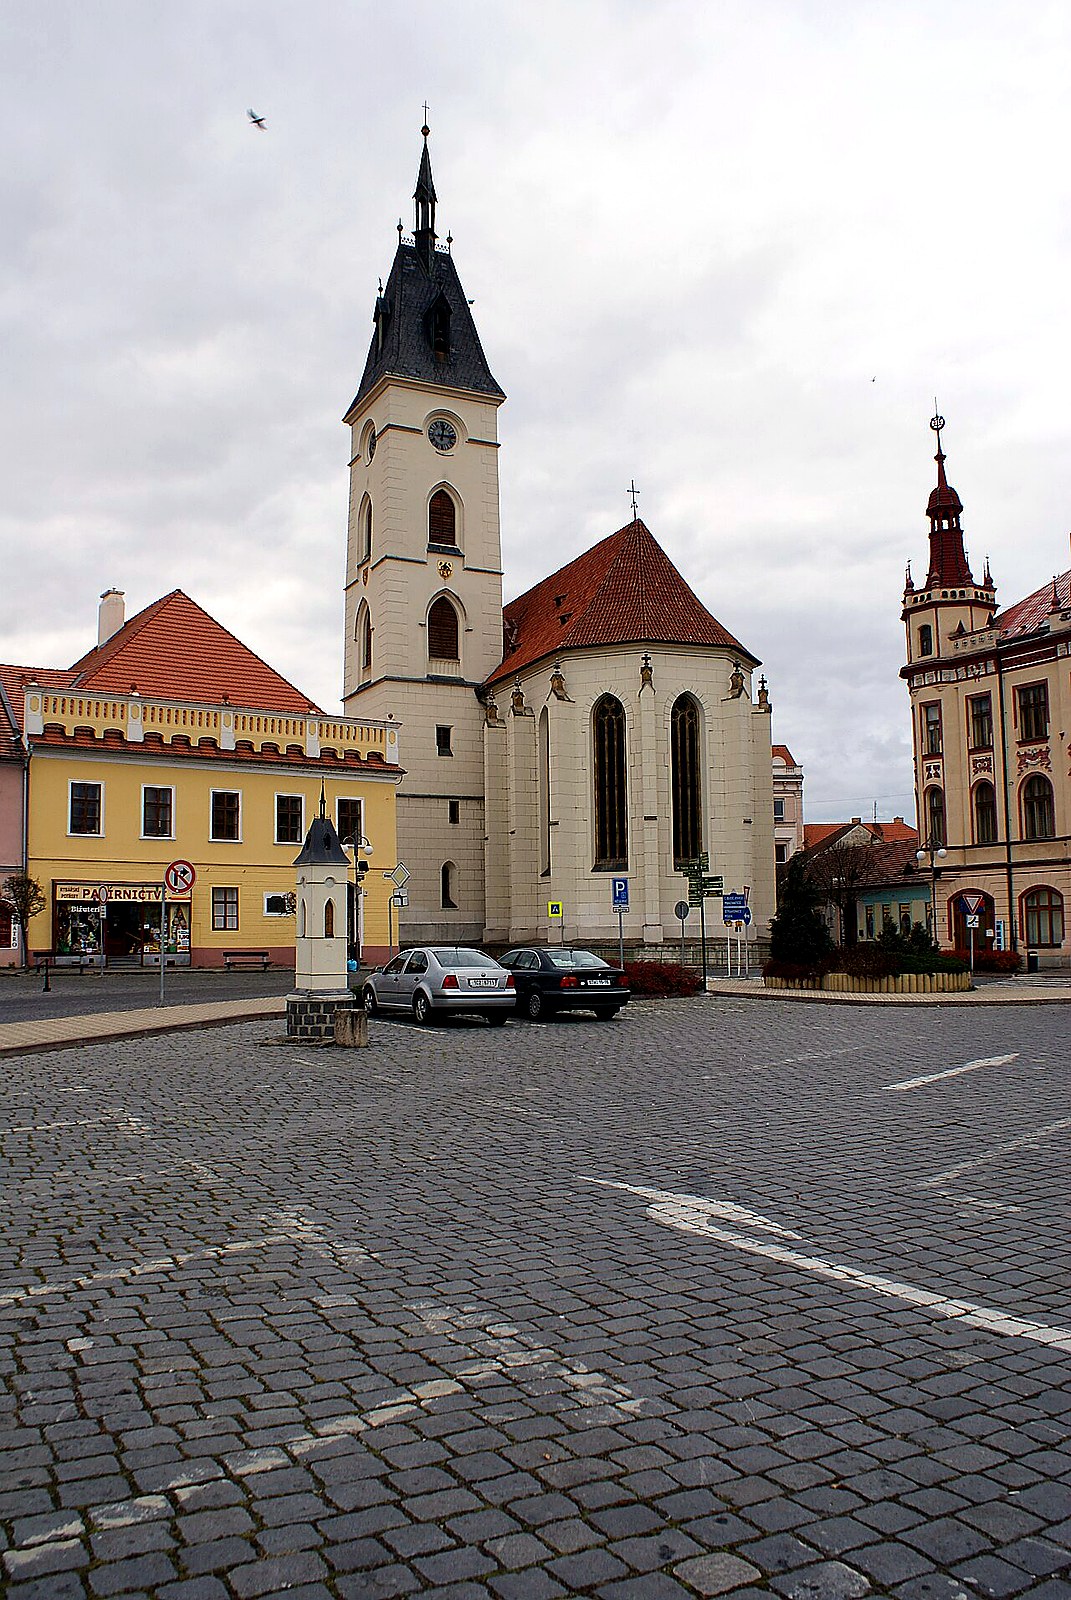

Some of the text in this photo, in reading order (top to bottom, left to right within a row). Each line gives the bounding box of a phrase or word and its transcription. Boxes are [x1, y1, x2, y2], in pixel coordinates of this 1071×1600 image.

[82, 886, 167, 900] PAÍRNICTV
[615, 881, 625, 897] P
[70, 905, 100, 913] Bižuteri
